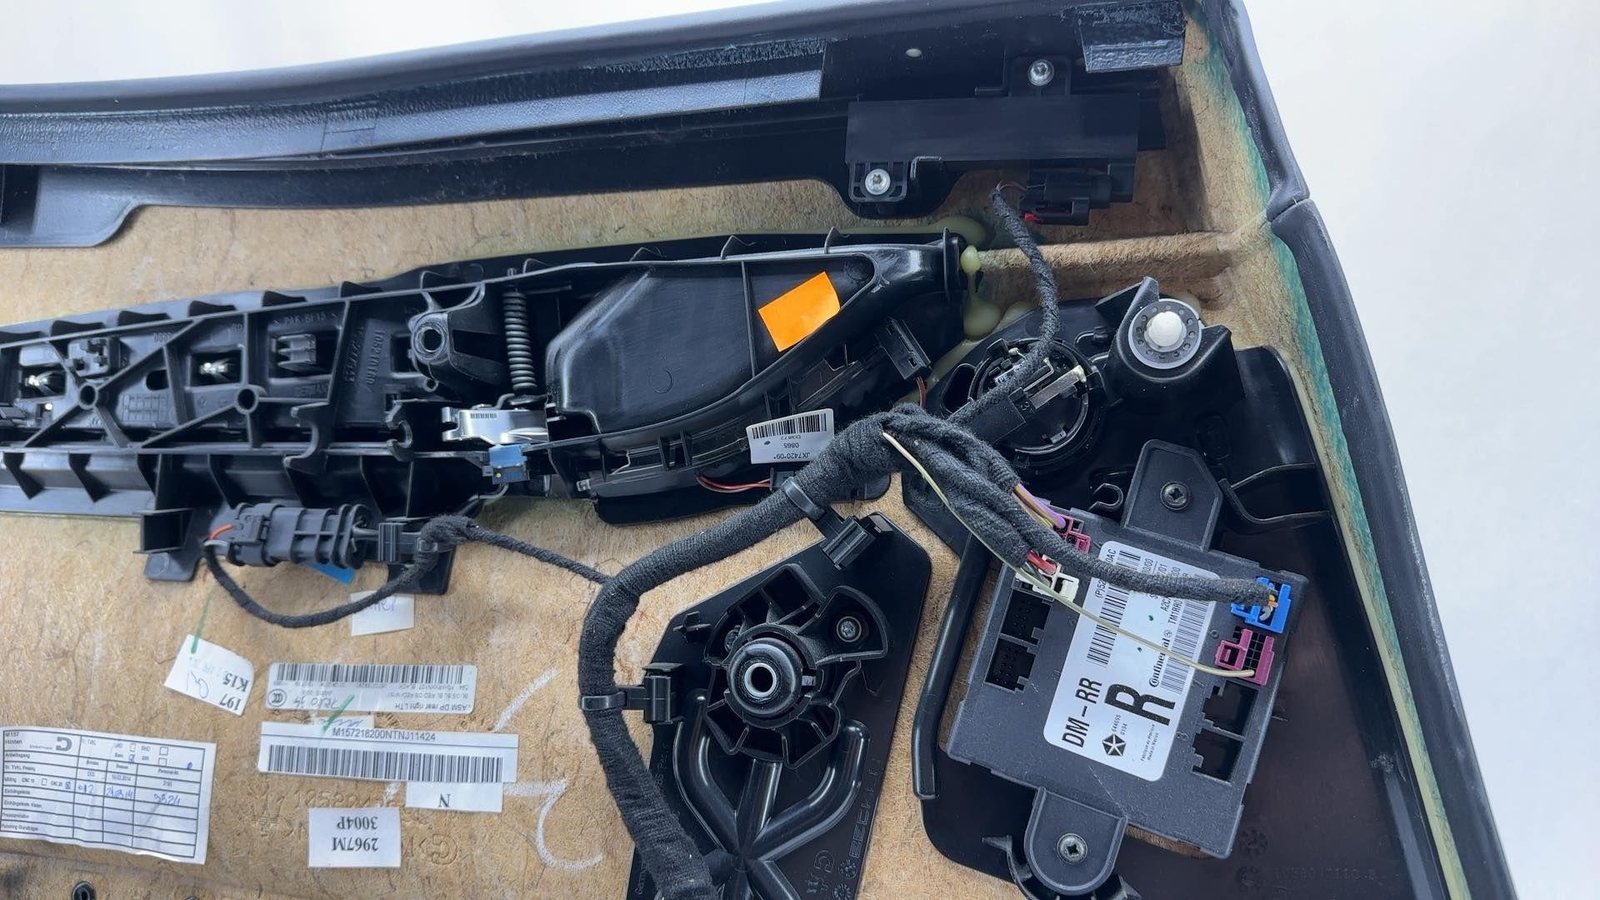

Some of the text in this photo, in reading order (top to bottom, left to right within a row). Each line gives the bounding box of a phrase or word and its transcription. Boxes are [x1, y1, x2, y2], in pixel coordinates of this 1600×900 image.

[224, 671, 249, 693] K15
[219, 690, 241, 710] 197
[409, 701, 423, 710] right
[1104, 683, 1176, 726] R
[332, 727, 436, 741] M157218200NTNJ11424
[439, 793, 451, 808] N
[336, 816, 378, 829] 3004P
[332, 837, 379, 851] 2967M
